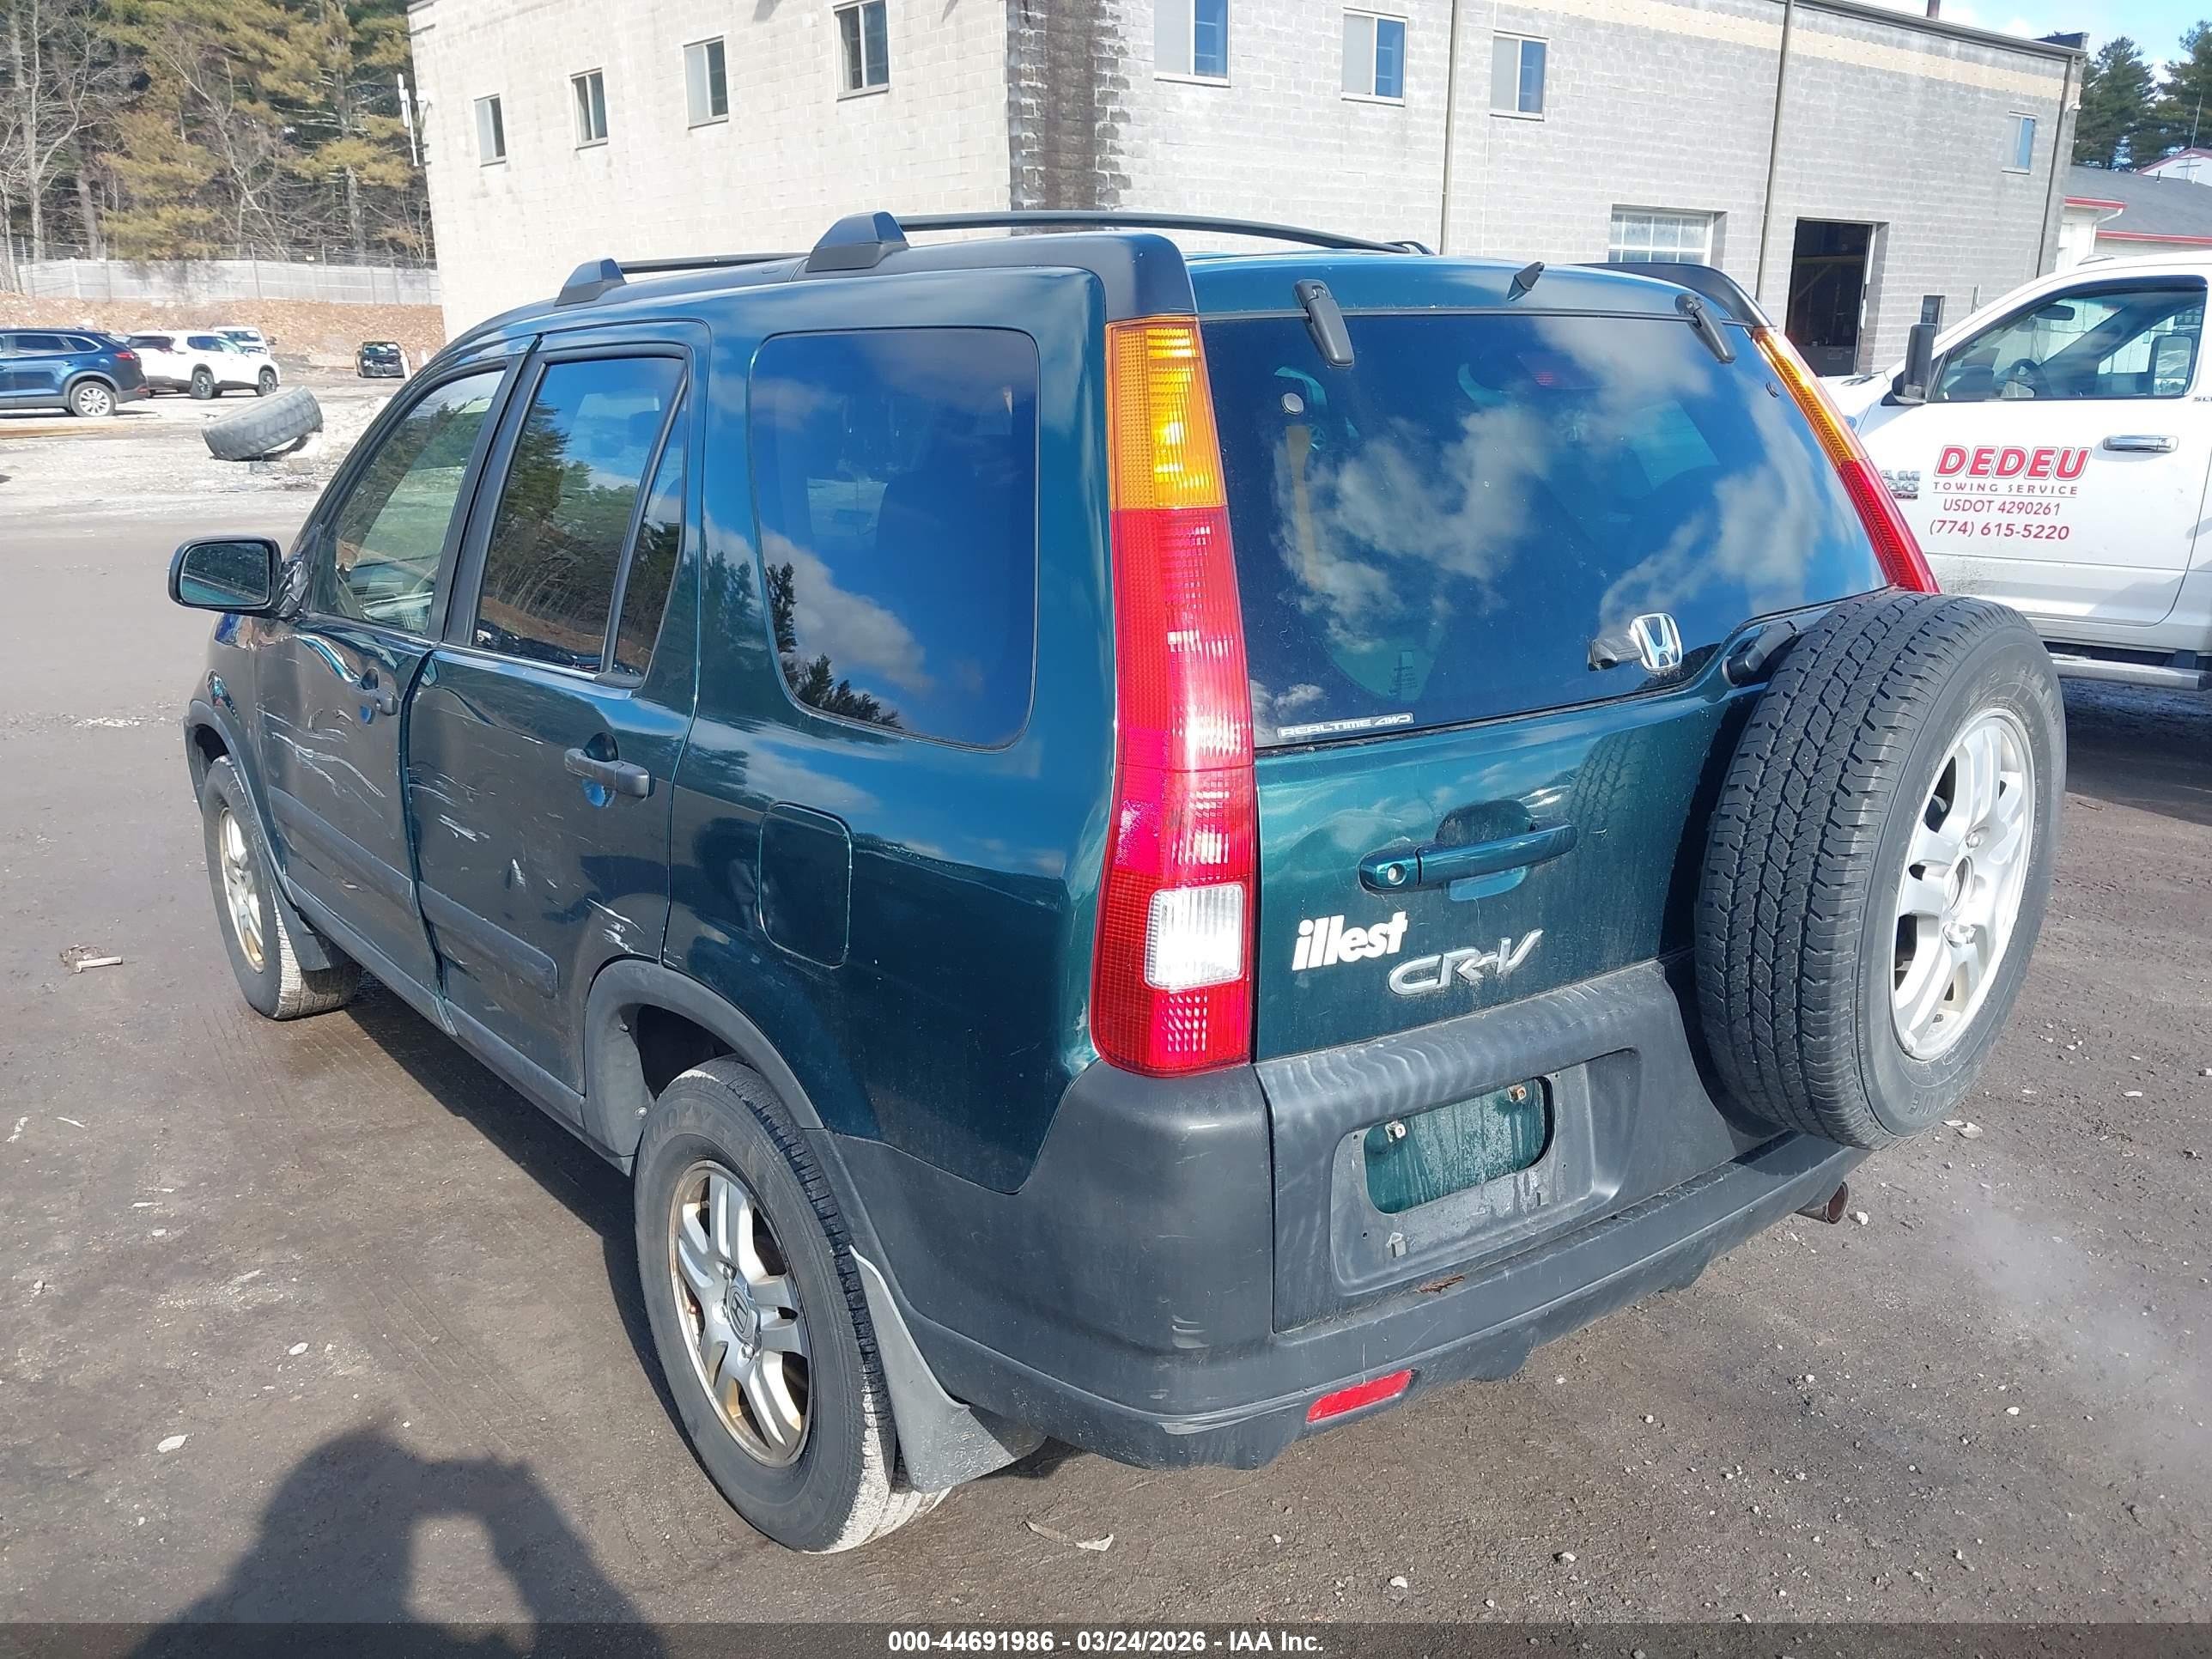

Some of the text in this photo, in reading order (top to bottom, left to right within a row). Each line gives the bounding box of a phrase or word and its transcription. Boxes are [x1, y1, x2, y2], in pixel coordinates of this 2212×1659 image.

[1936, 446, 2090, 479] DEDEU
[1933, 482, 2078, 495] TOWING SERVICE
[1942, 498, 2061, 516] USDOT 4290261
[1929, 519, 2070, 540] (774) 615-5220
[1291, 911, 1408, 971] illest
[1388, 927, 1544, 996] CR-V
